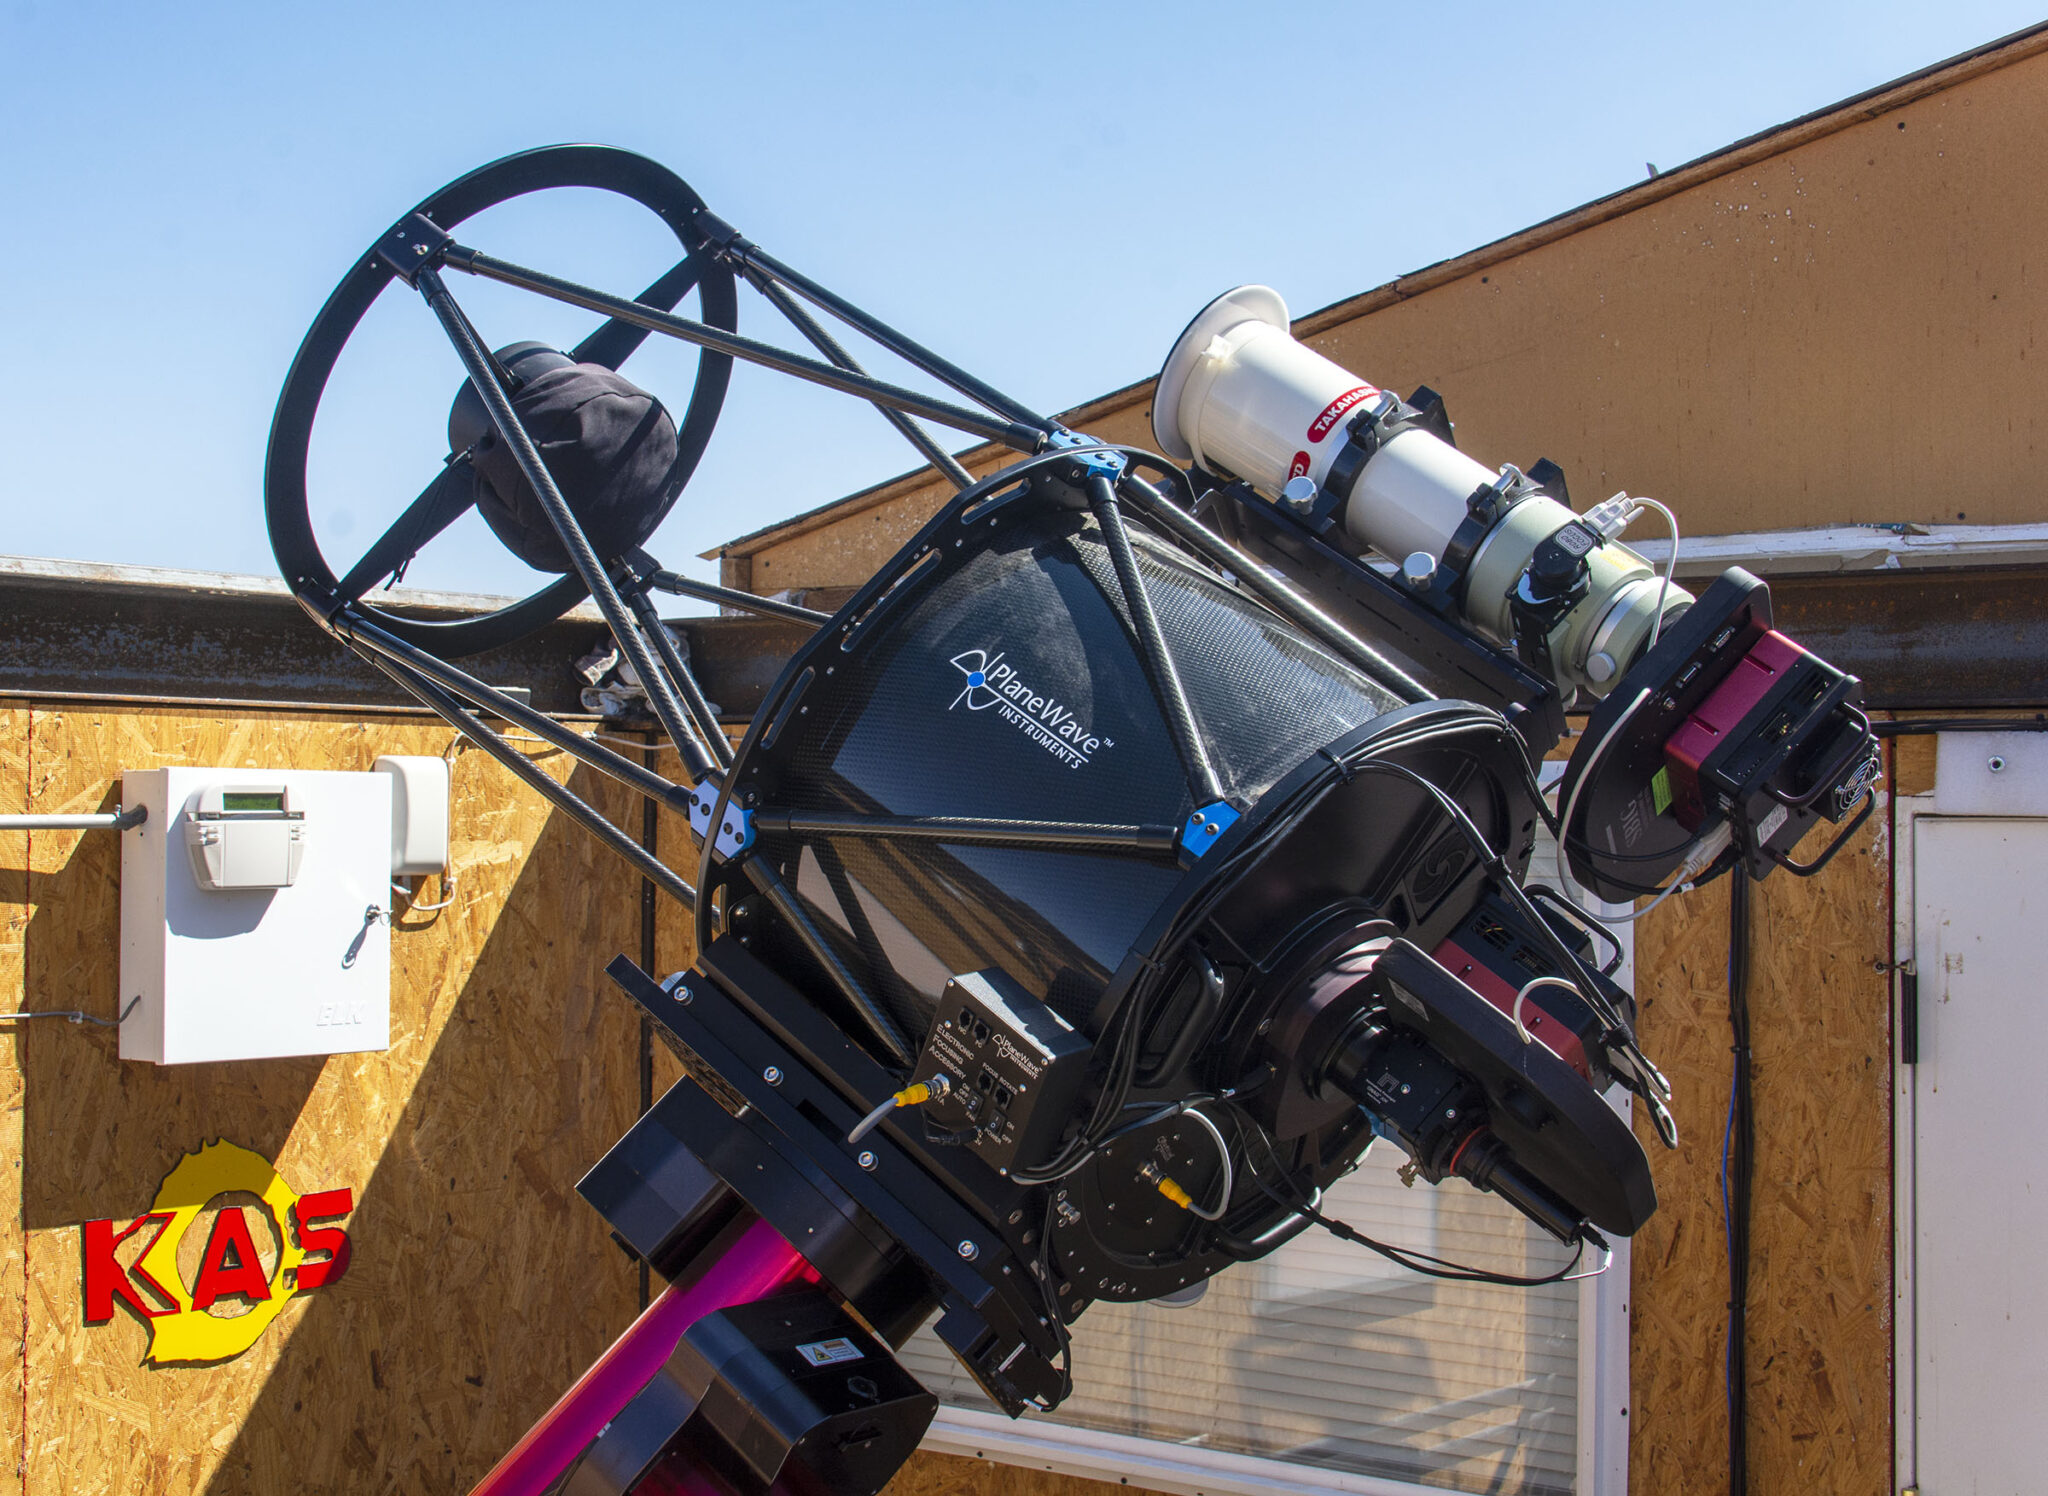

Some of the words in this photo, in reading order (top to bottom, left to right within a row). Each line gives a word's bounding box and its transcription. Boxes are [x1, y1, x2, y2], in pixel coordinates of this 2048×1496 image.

[987, 663, 1100, 754] PlaneWave
[998, 704, 1082, 769] INSTRUMENTS
[933, 1034, 963, 1064] FOCUSING
[936, 1023, 974, 1060] ELECTRONIC
[928, 1045, 966, 1079] ACCESSORY
[982, 1062, 999, 1078] FOCUS
[999, 1076, 1018, 1095] ROTATE
[85, 1187, 354, 1322] KAS
